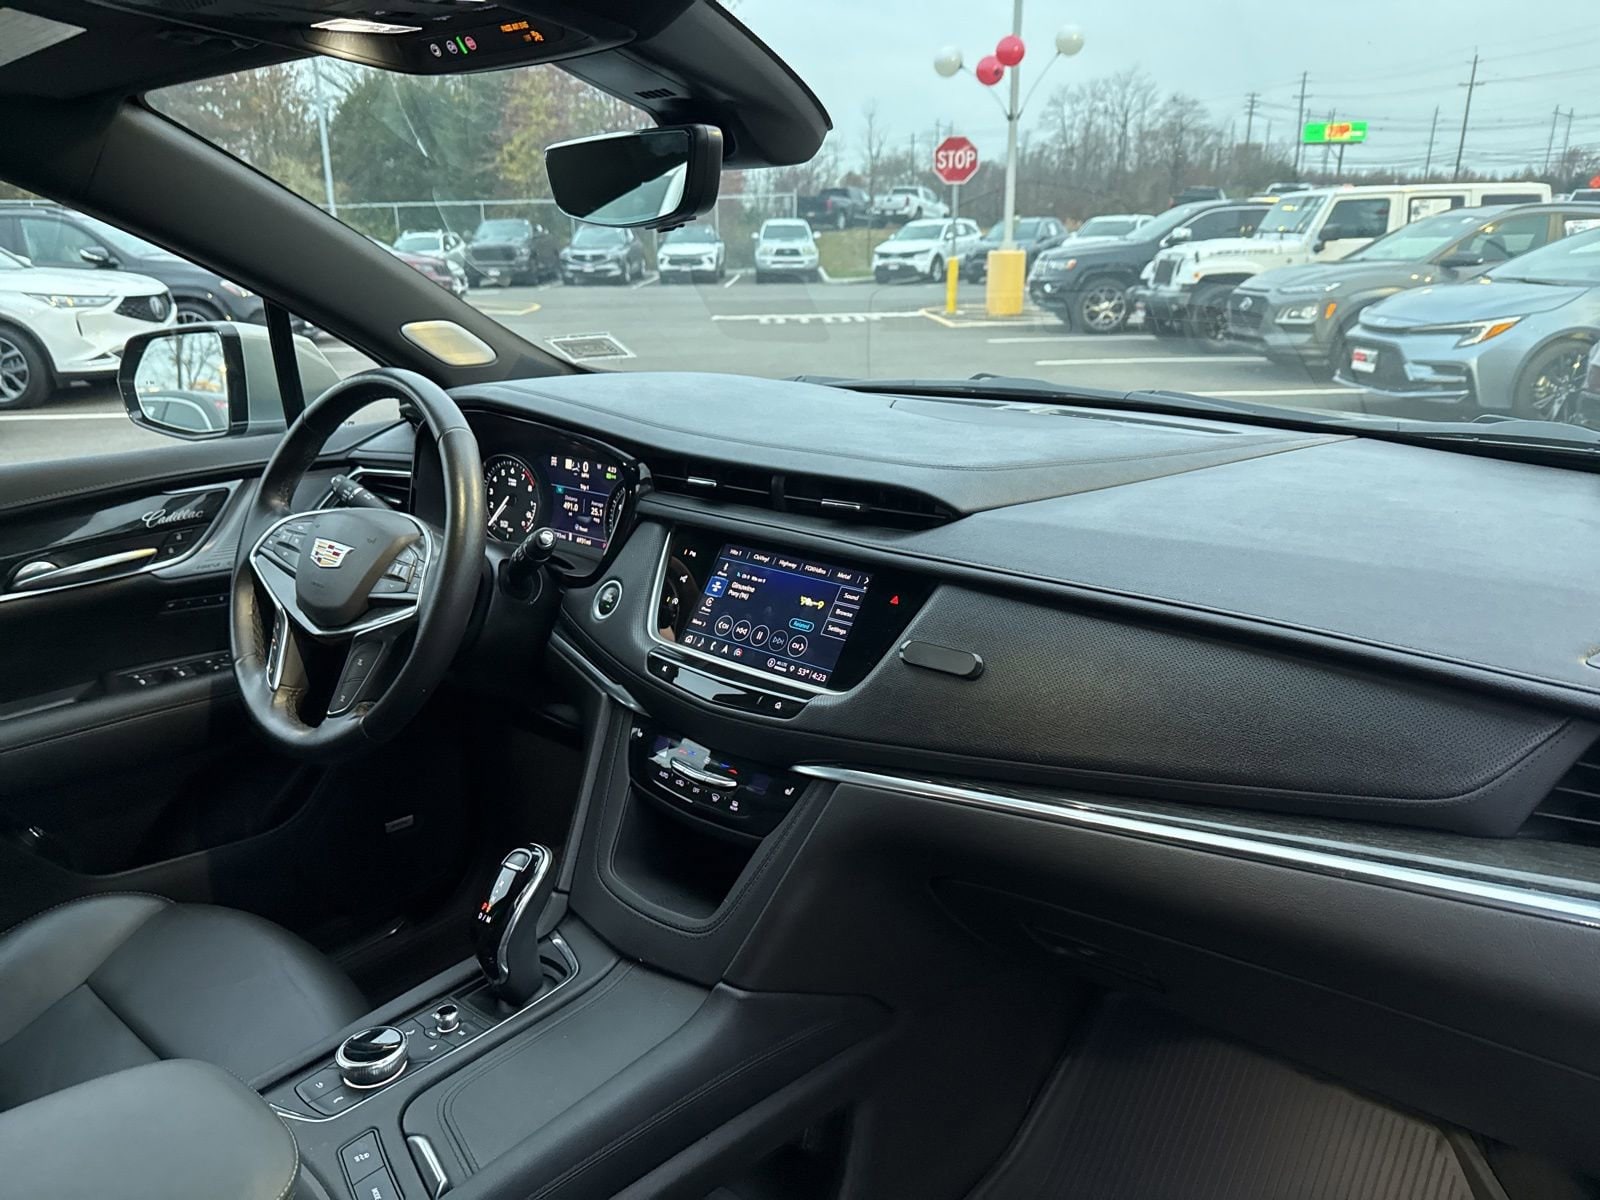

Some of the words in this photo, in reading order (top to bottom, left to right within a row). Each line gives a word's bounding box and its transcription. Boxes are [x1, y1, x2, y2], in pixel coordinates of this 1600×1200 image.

[936, 150, 976, 169] STOP
[563, 501, 579, 512] 491.0
[590, 507, 603, 517] 25.1
[142, 508, 204, 528] Cadillac
[843, 592, 860, 601] Sound
[835, 608, 854, 618] Browse
[827, 624, 847, 636] Settings
[811, 672, 827, 683] 4:23
